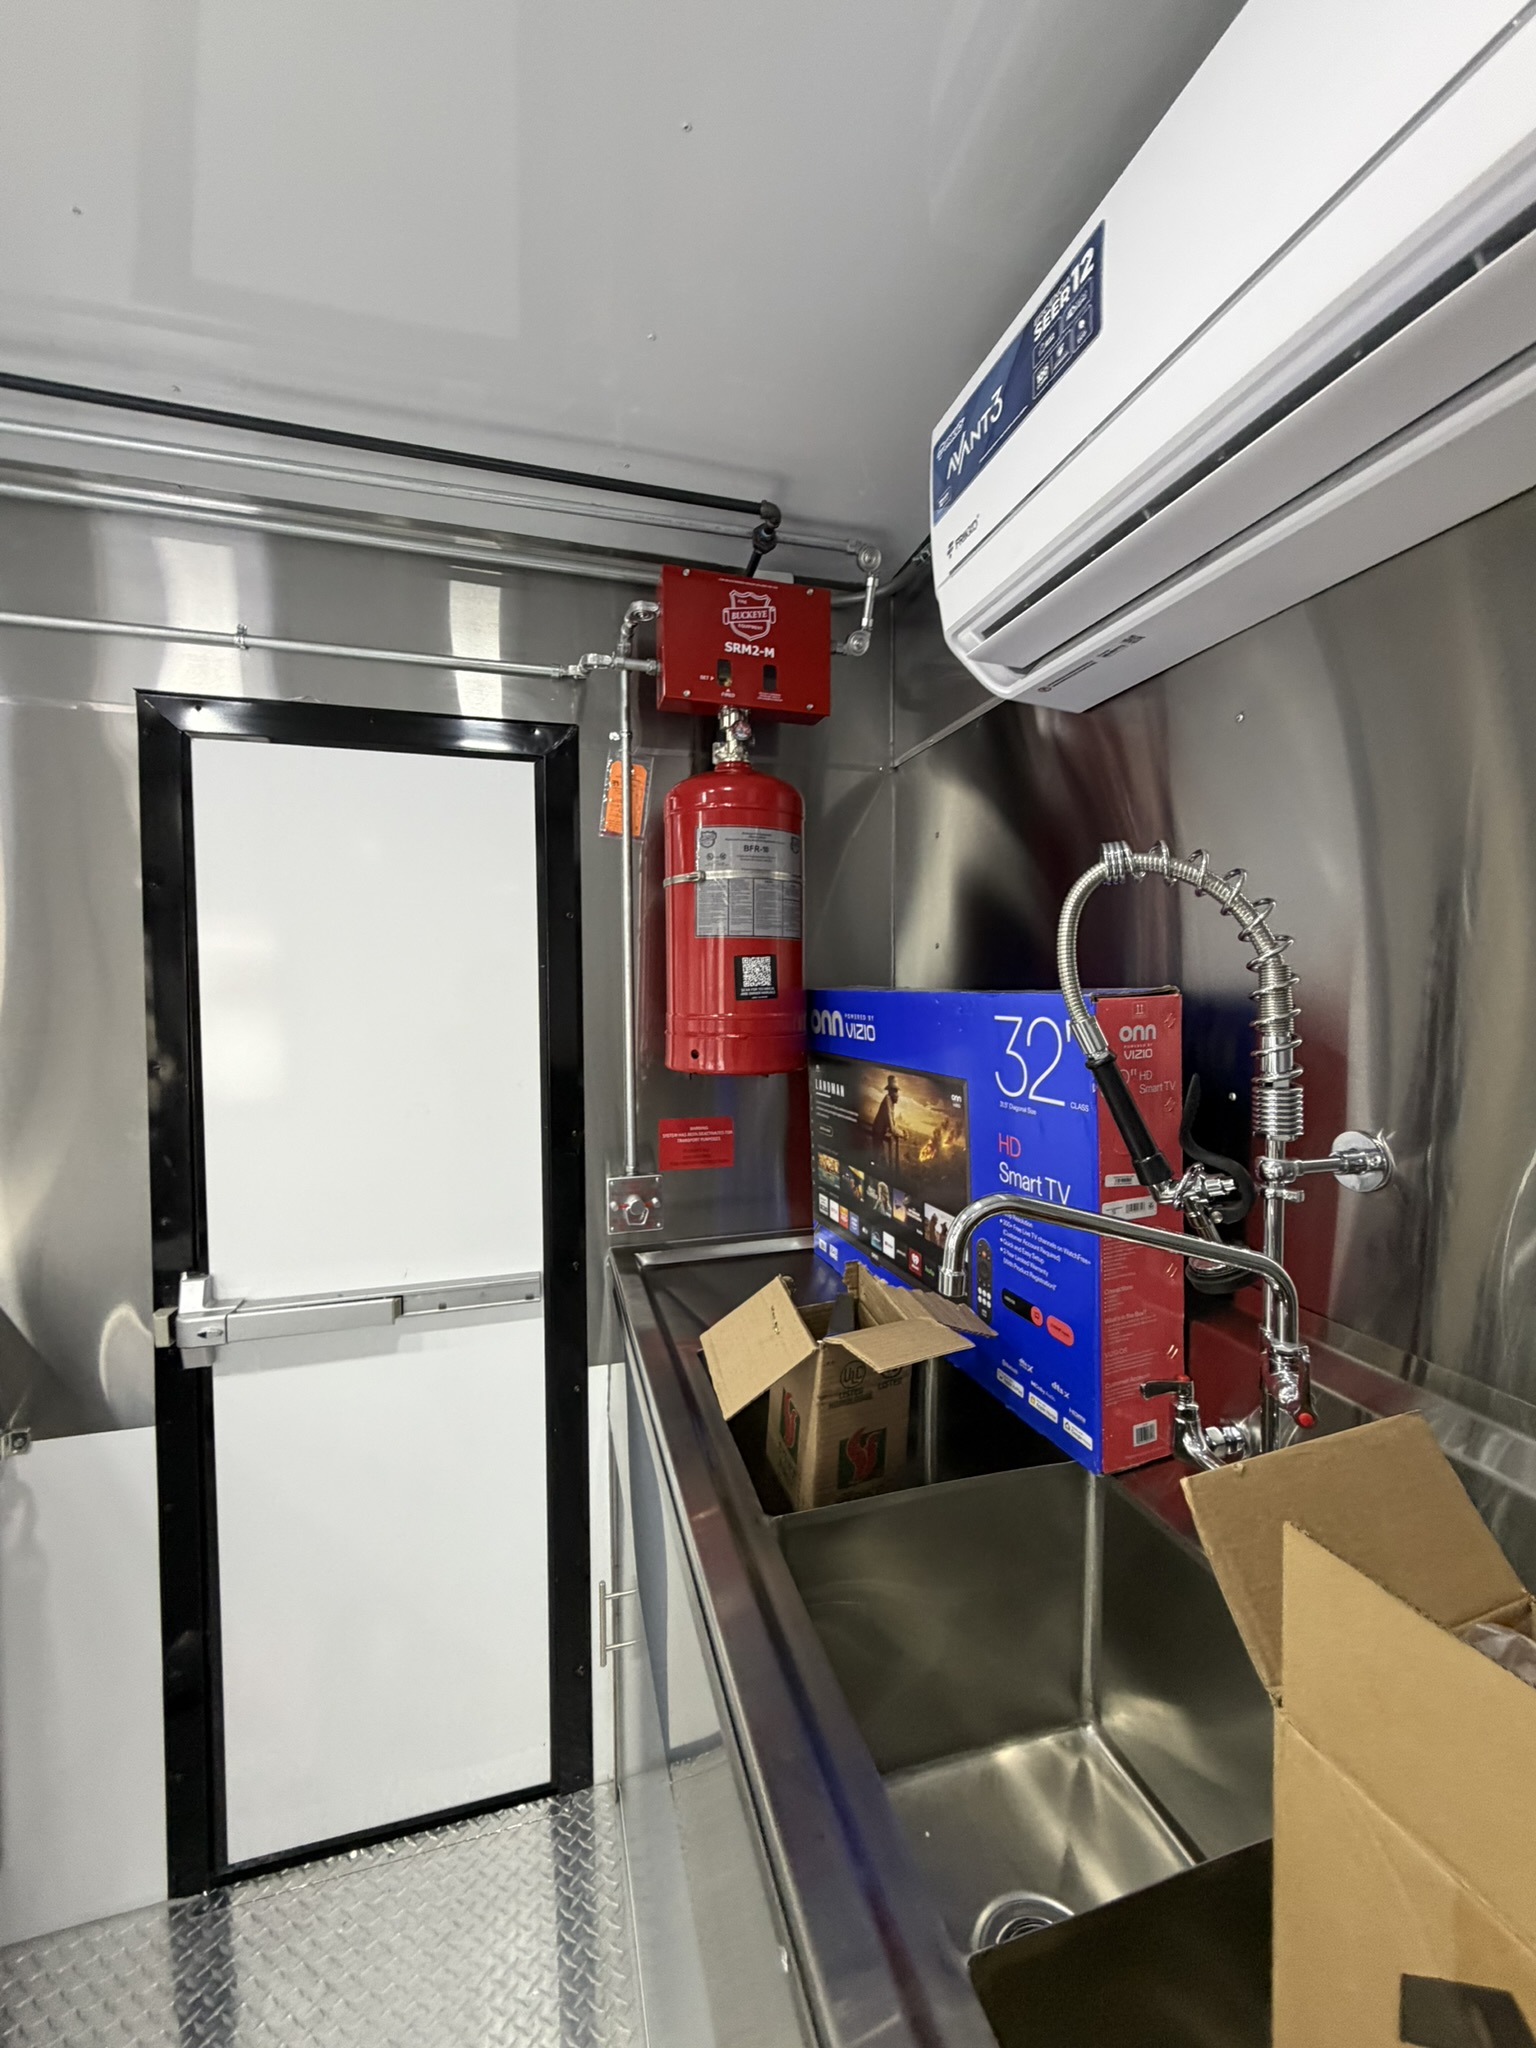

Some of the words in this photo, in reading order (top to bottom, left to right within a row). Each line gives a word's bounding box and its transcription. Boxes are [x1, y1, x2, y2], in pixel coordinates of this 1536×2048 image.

[1034, 286, 1071, 343] SEER
[1071, 247, 1094, 293] 12
[731, 610, 768, 620] BUCKEYE
[724, 641, 775, 658] SRM2-M
[811, 1008, 844, 1037] onn
[845, 1022, 876, 1042] VIZIO
[1119, 1024, 1157, 1042] onn
[1123, 1048, 1153, 1060] VIZIO
[1139, 1069, 1152, 1080] HD
[1139, 1083, 1163, 1094] Smart
[1164, 1080, 1176, 1091] TV
[1070, 1101, 1089, 1113] CLASS
[998, 1132, 1021, 1158] HD
[999, 1161, 1043, 1197] Smart
[1044, 1176, 1071, 1205] TV
